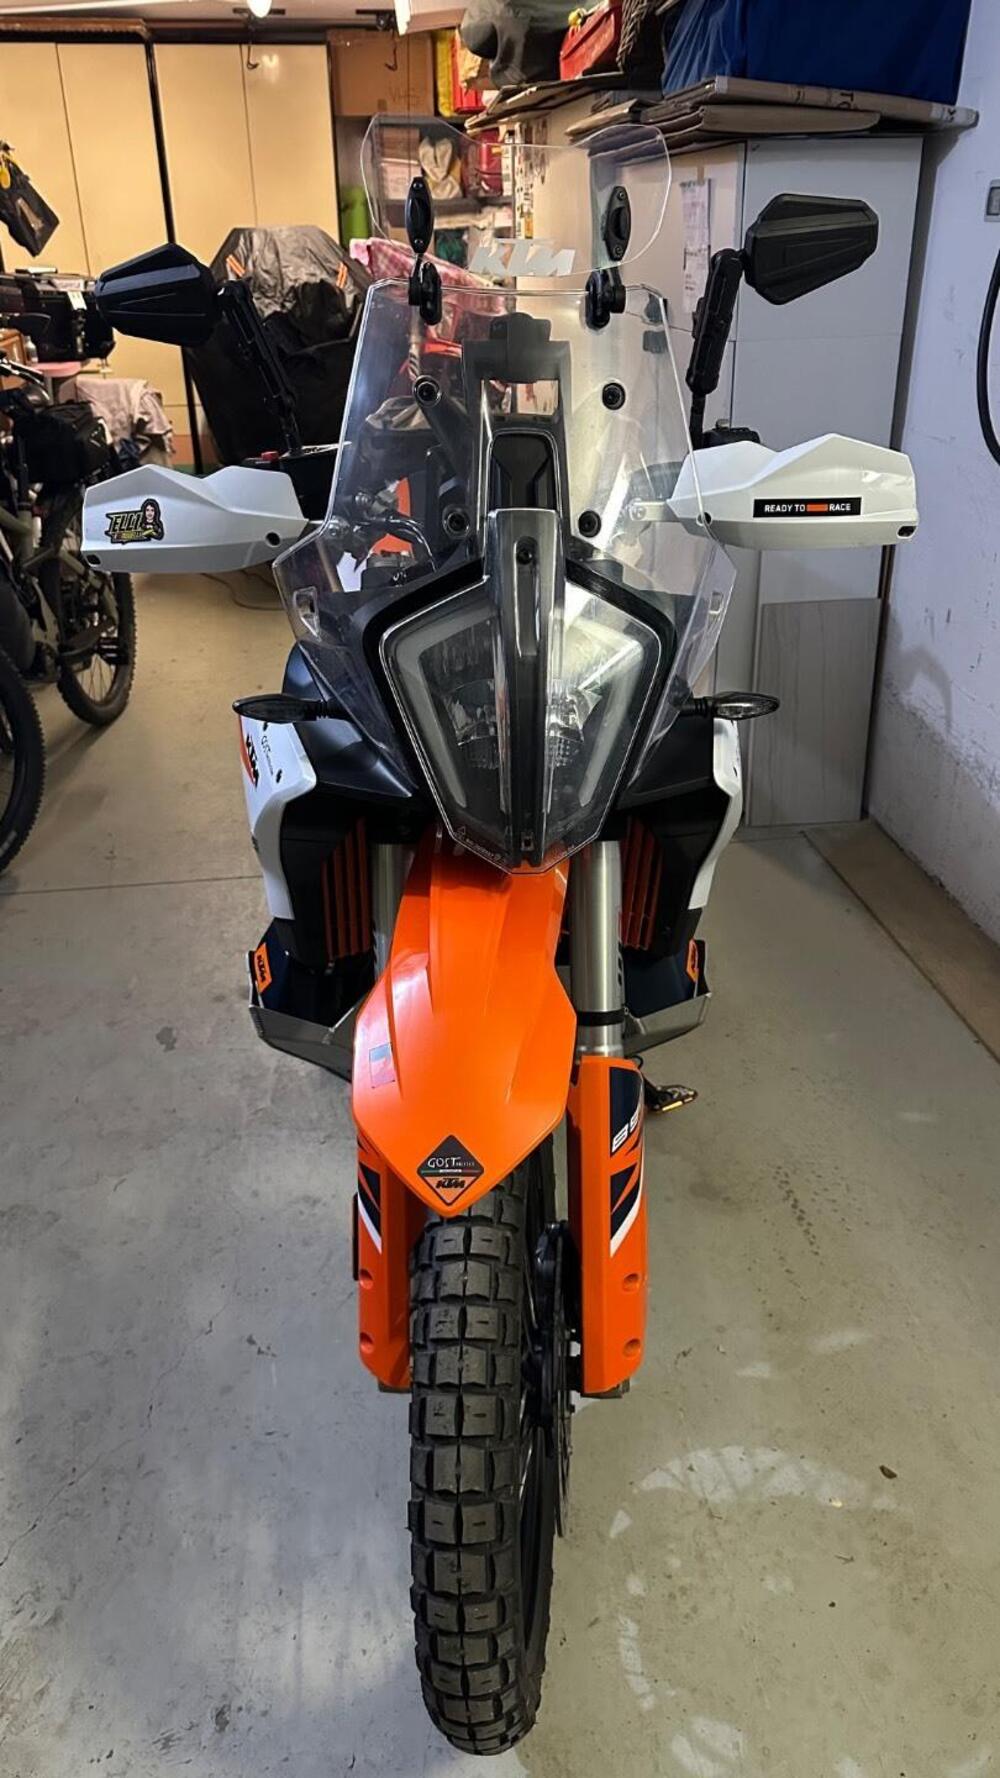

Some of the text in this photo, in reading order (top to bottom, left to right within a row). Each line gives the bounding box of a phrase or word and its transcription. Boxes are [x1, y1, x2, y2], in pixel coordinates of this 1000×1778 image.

[467, 238, 576, 278] KTM
[764, 502, 852, 513] READY TO RACE
